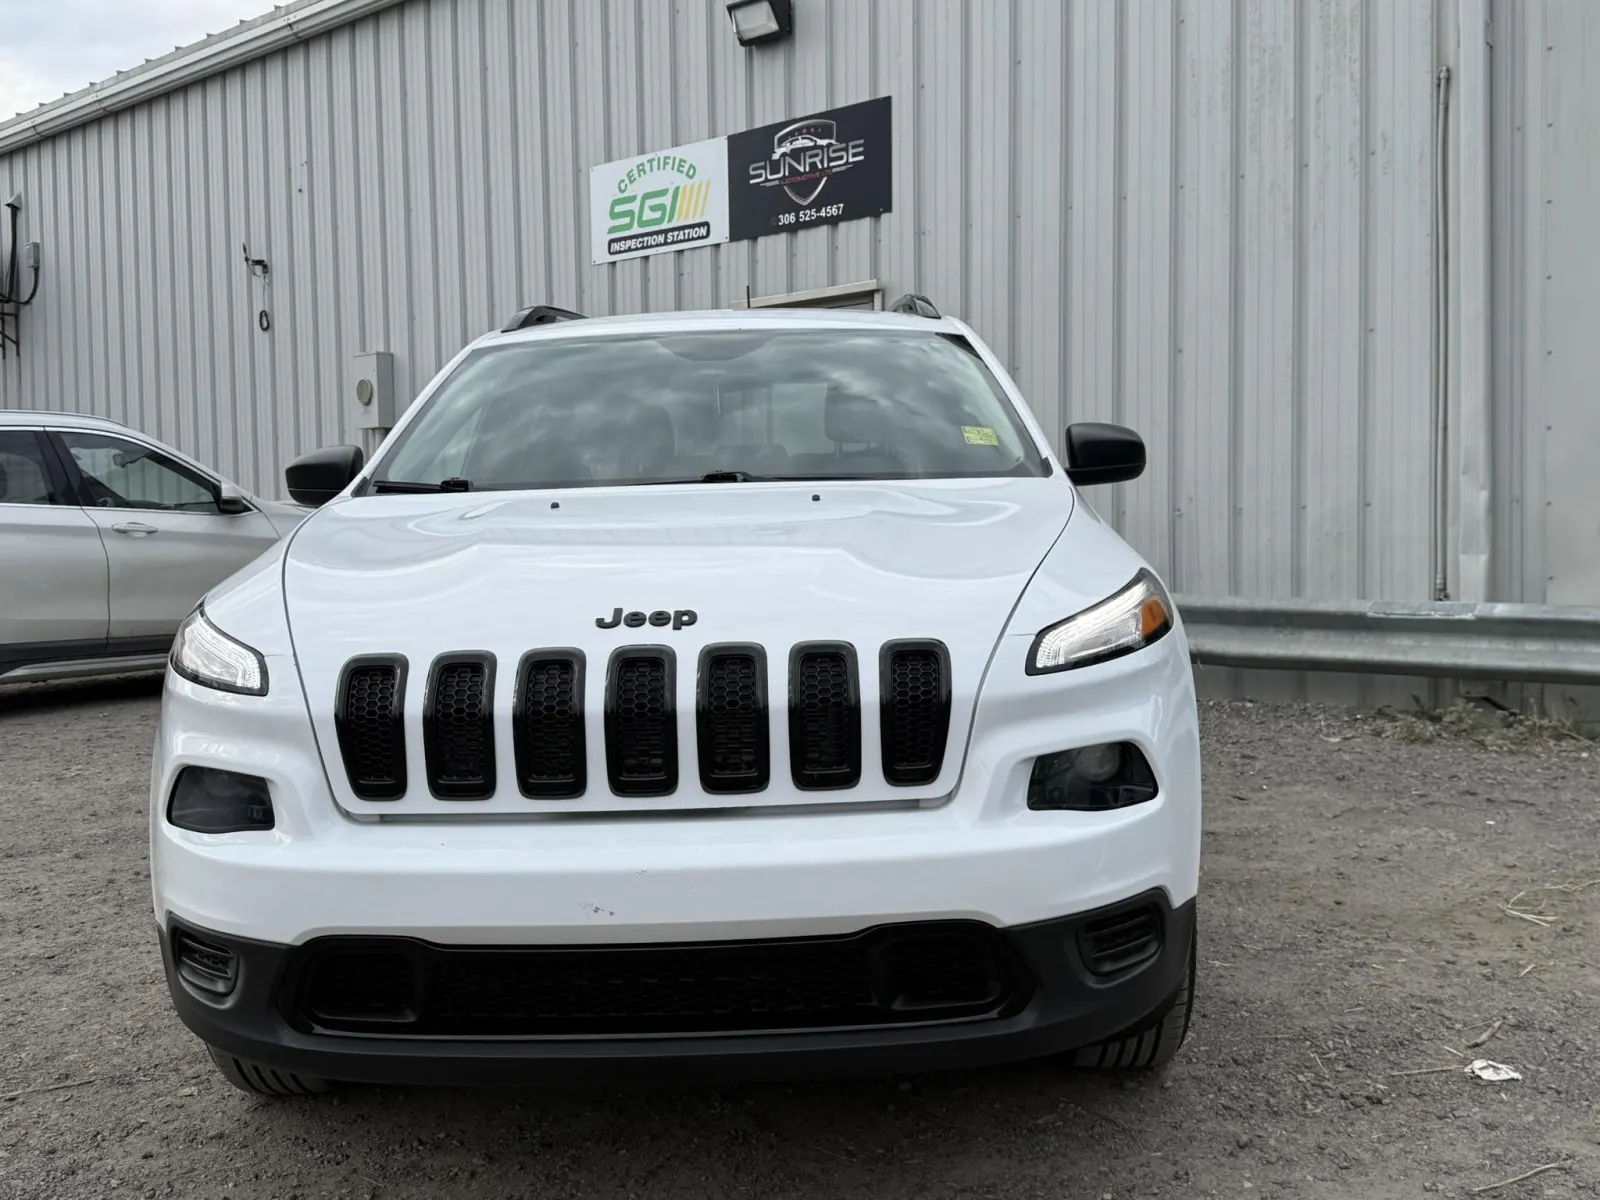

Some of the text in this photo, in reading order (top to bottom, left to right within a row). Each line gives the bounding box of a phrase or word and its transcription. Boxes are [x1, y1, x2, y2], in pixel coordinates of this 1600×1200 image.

[618, 156, 697, 193] CERTIFIED
[749, 139, 865, 184] SUNRISE
[607, 185, 681, 234] SGI
[778, 203, 844, 226] 306 525-4567
[610, 225, 708, 253] INSPECTION STATION
[595, 607, 698, 631] Jeep
